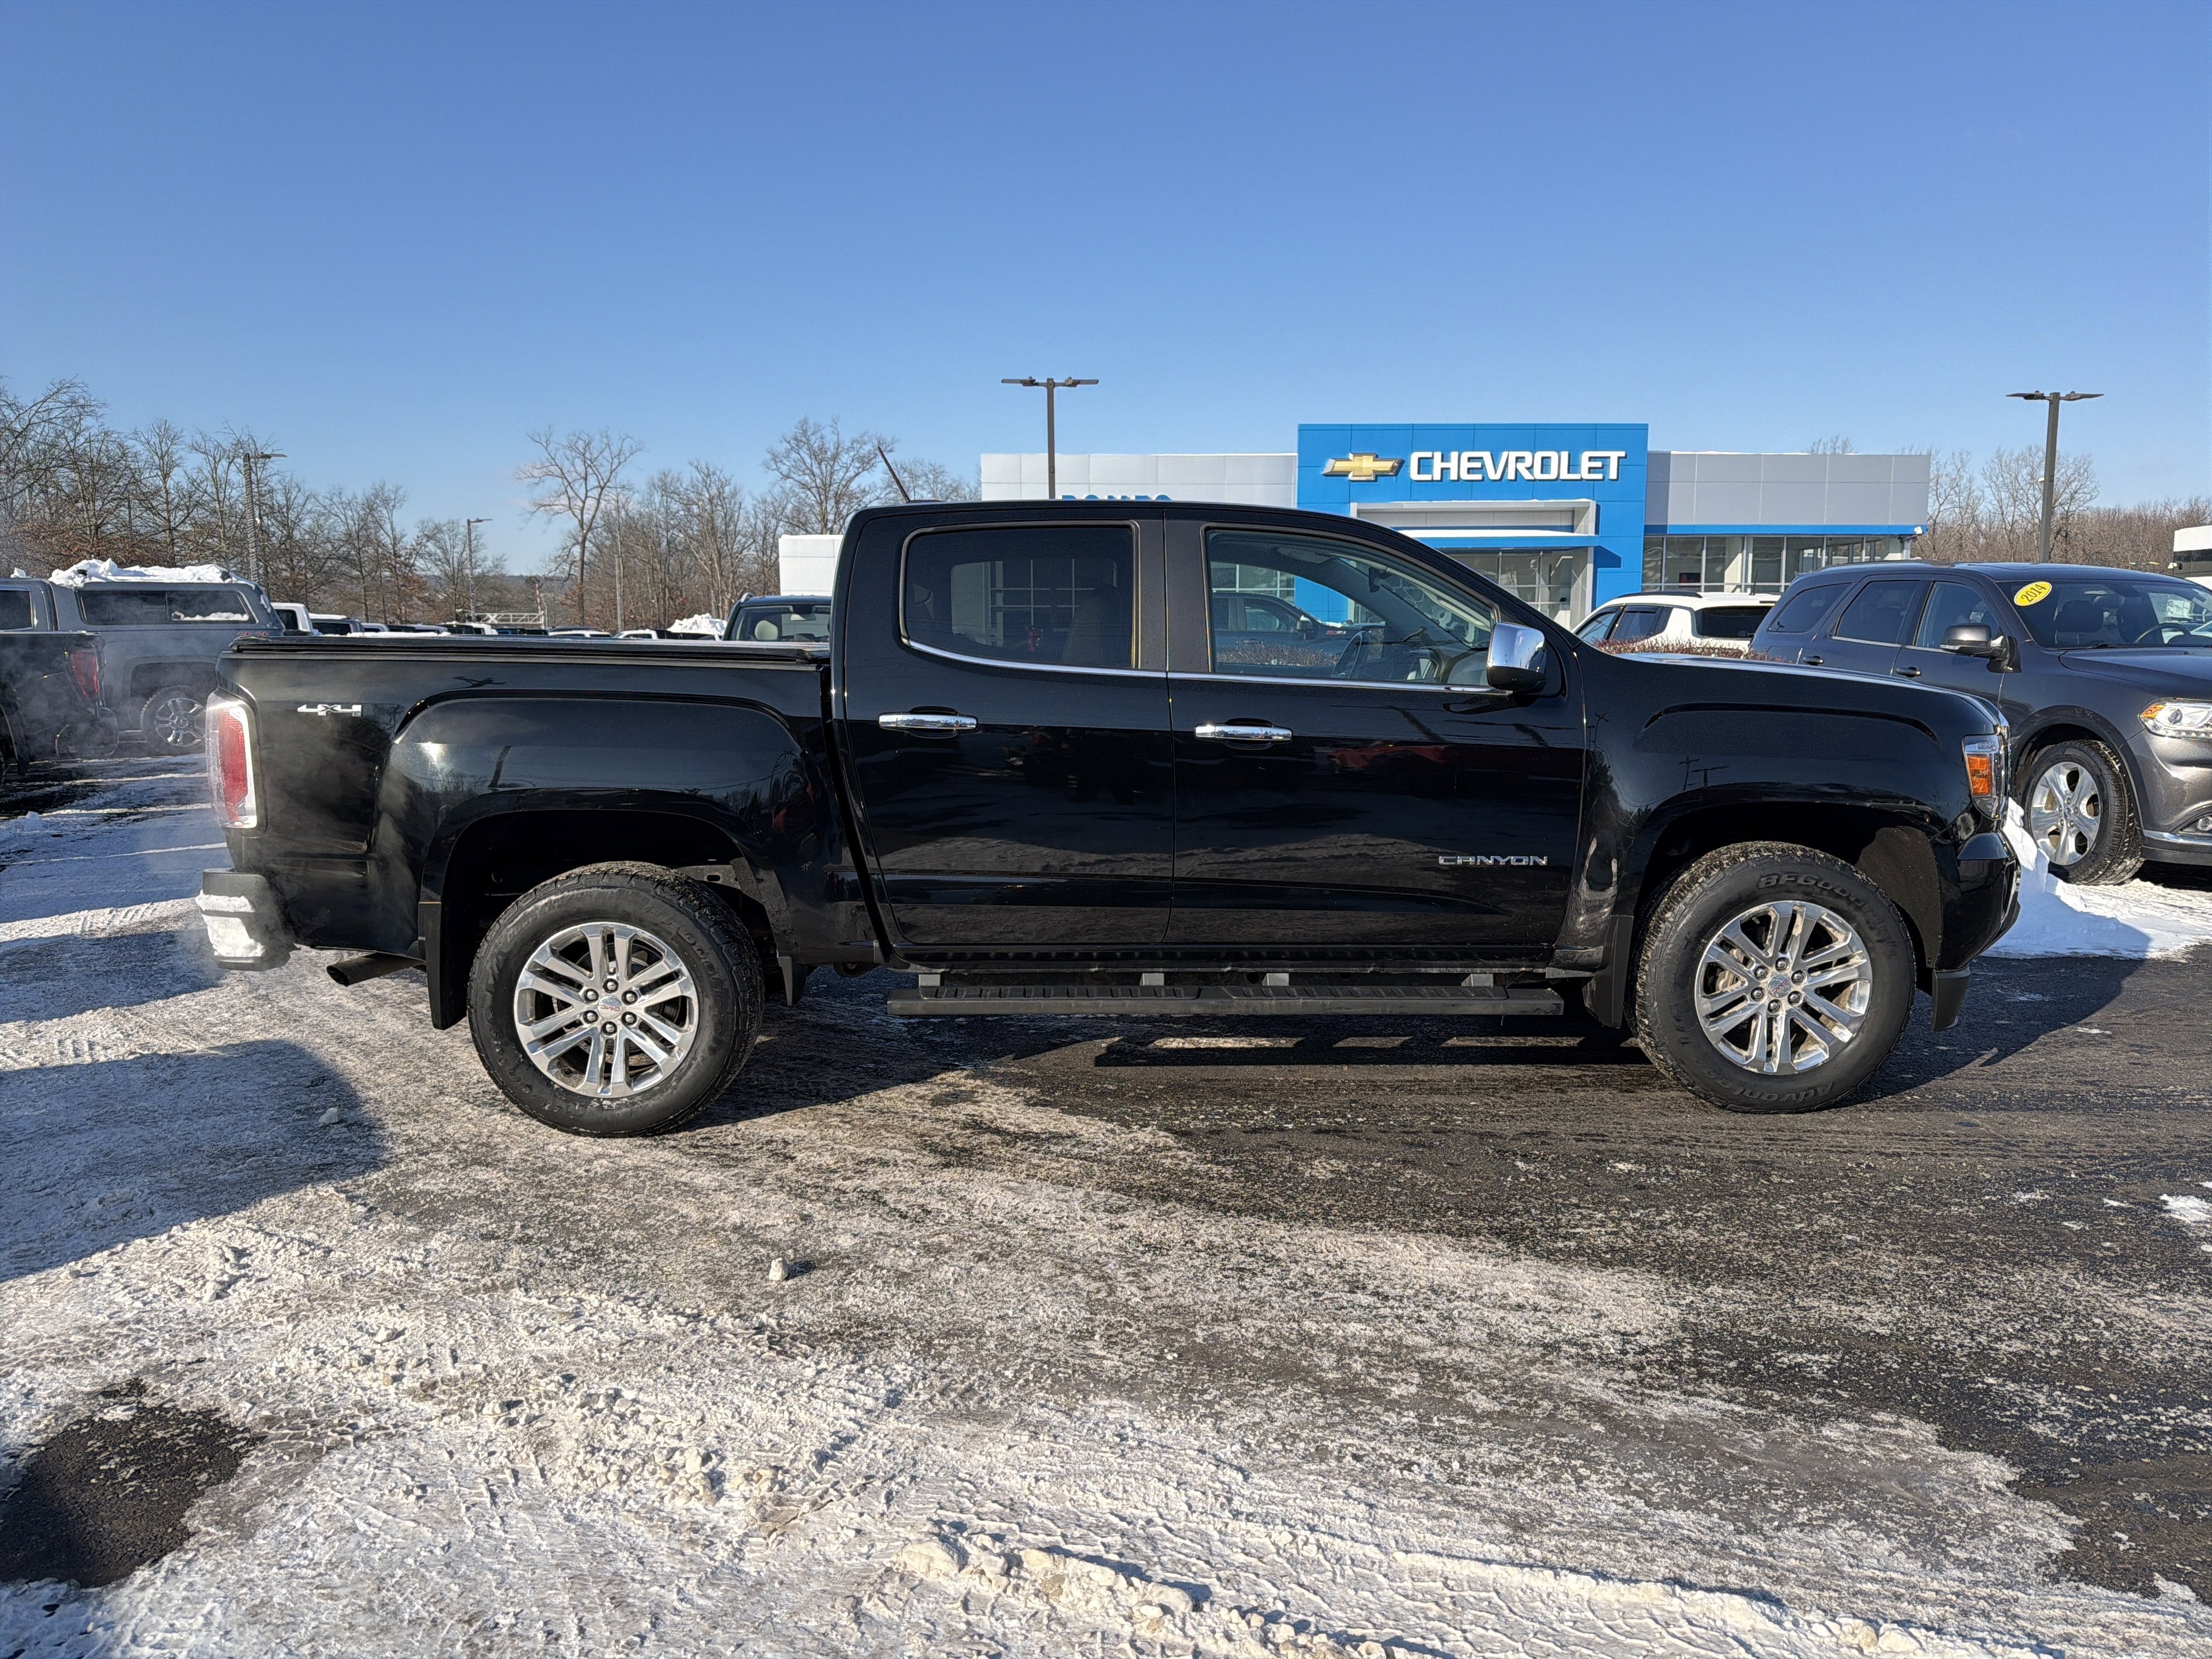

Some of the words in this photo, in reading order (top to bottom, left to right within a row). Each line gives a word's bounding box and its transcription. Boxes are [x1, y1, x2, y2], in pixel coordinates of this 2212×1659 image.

[1410, 451, 1626, 481] CHEVROLET
[2021, 584, 2047, 602] 2014
[1438, 856, 1548, 866] CANYON
[1771, 978, 1788, 994] GMC
